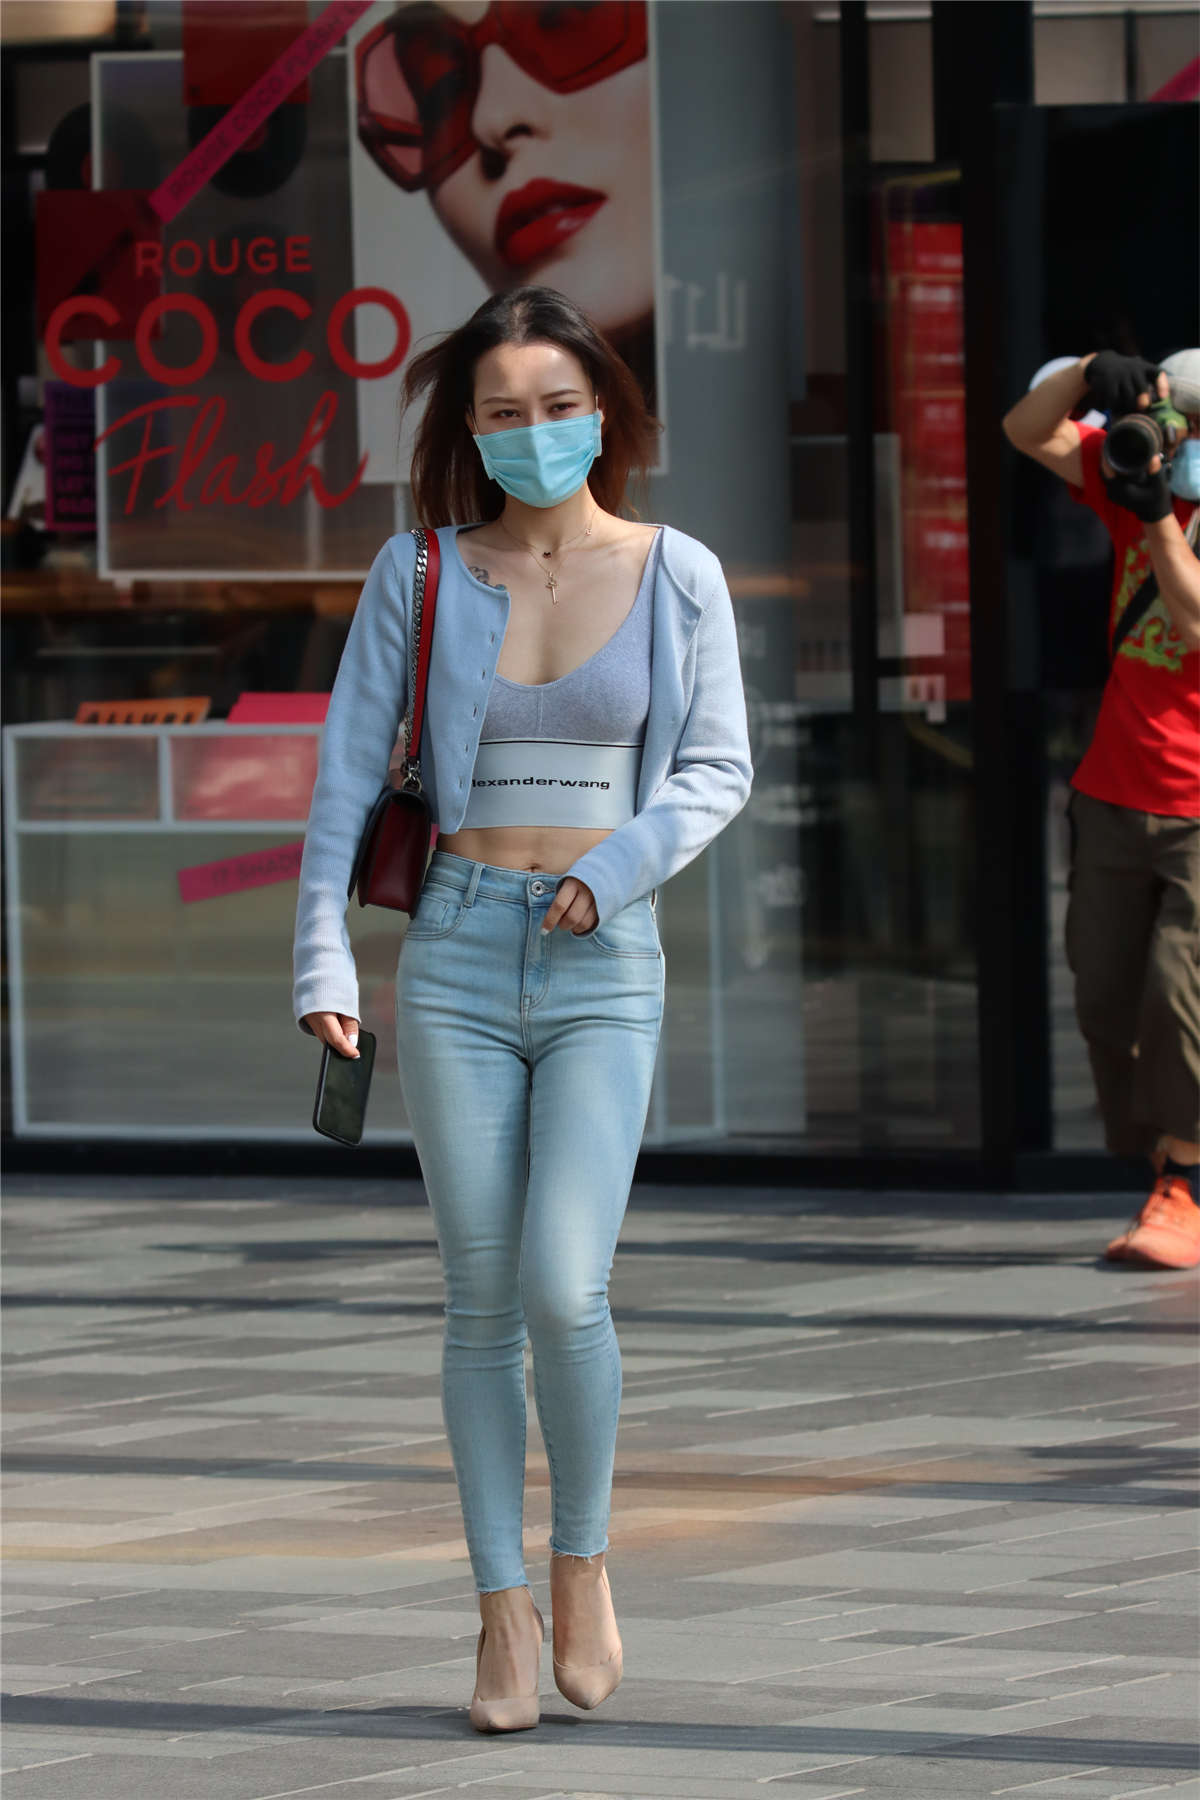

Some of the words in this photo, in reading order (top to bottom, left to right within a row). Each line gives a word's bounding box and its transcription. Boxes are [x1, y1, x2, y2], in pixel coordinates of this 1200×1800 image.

[231, 75, 284, 132] COCO
[135, 236, 312, 277] ROUGE
[45, 287, 411, 388] COCO
[95, 390, 369, 514] Flash
[472, 776, 611, 790] lexanderwang
